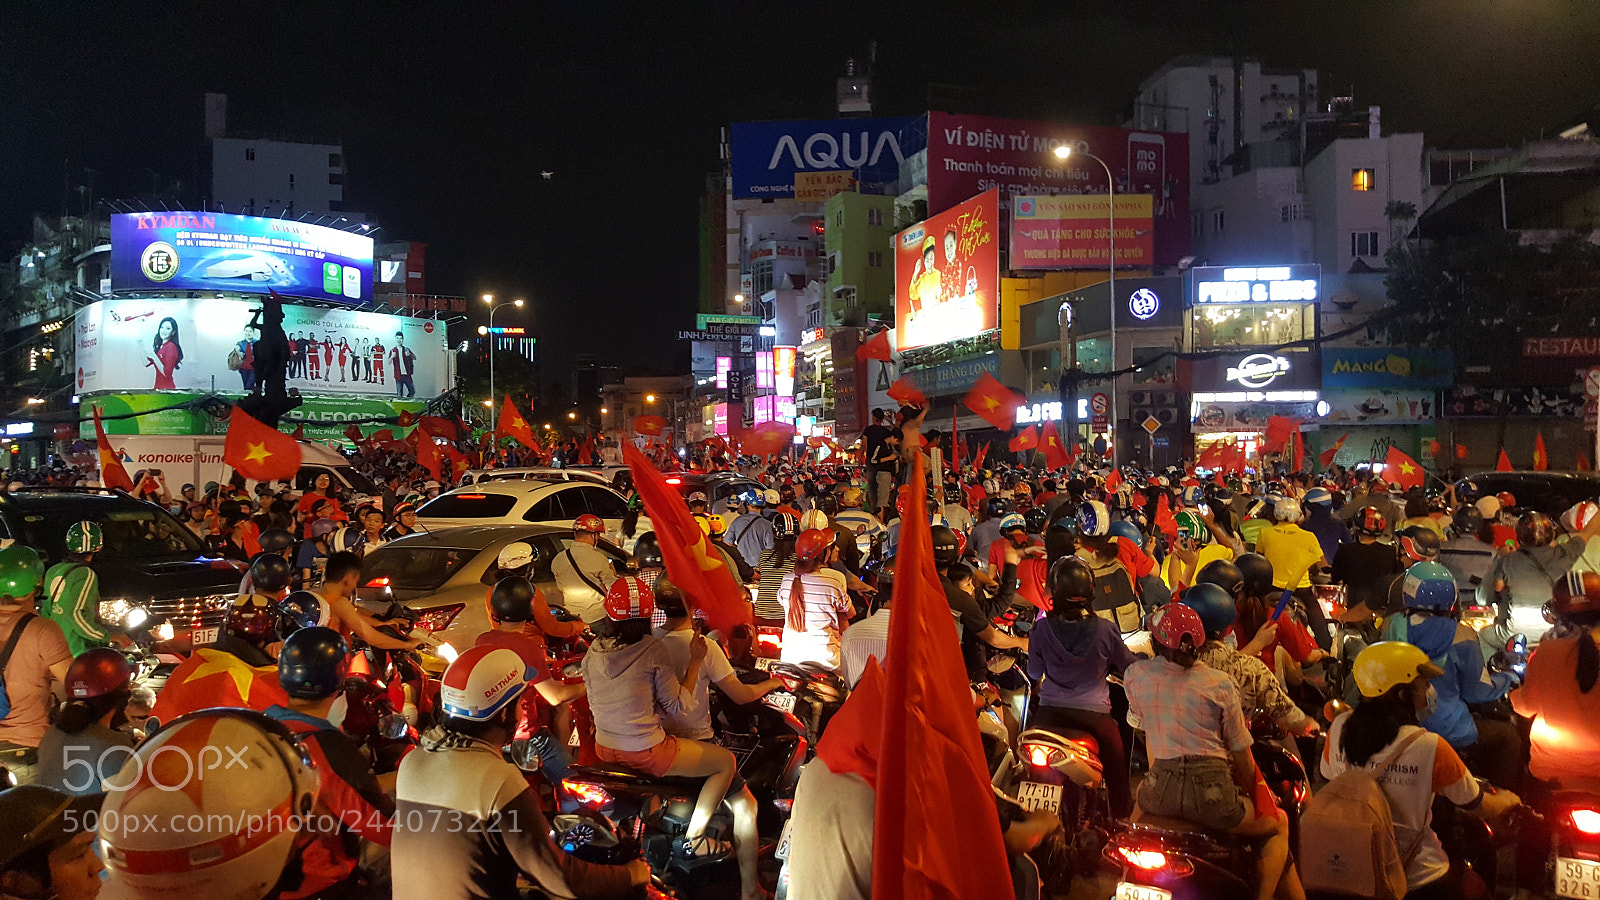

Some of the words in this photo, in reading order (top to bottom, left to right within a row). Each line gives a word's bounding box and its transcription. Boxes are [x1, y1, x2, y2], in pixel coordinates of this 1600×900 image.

[944, 126, 962, 145] VÍ
[966, 128, 1004, 152] ĐIỆN
[1008, 130, 1030, 151] TỬ
[768, 131, 906, 170] AQUA
[943, 158, 983, 173] Thanh
[986, 162, 1015, 176] toán
[1018, 167, 1043, 178] mọi
[1067, 167, 1089, 181] tiêu
[137, 215, 216, 229] KYMDAN
[1032, 227, 1049, 240] QUÀ
[1051, 227, 1073, 241] TẶNG
[1075, 229, 1092, 240] CHO
[1527, 338, 1600, 355] RESTAU
